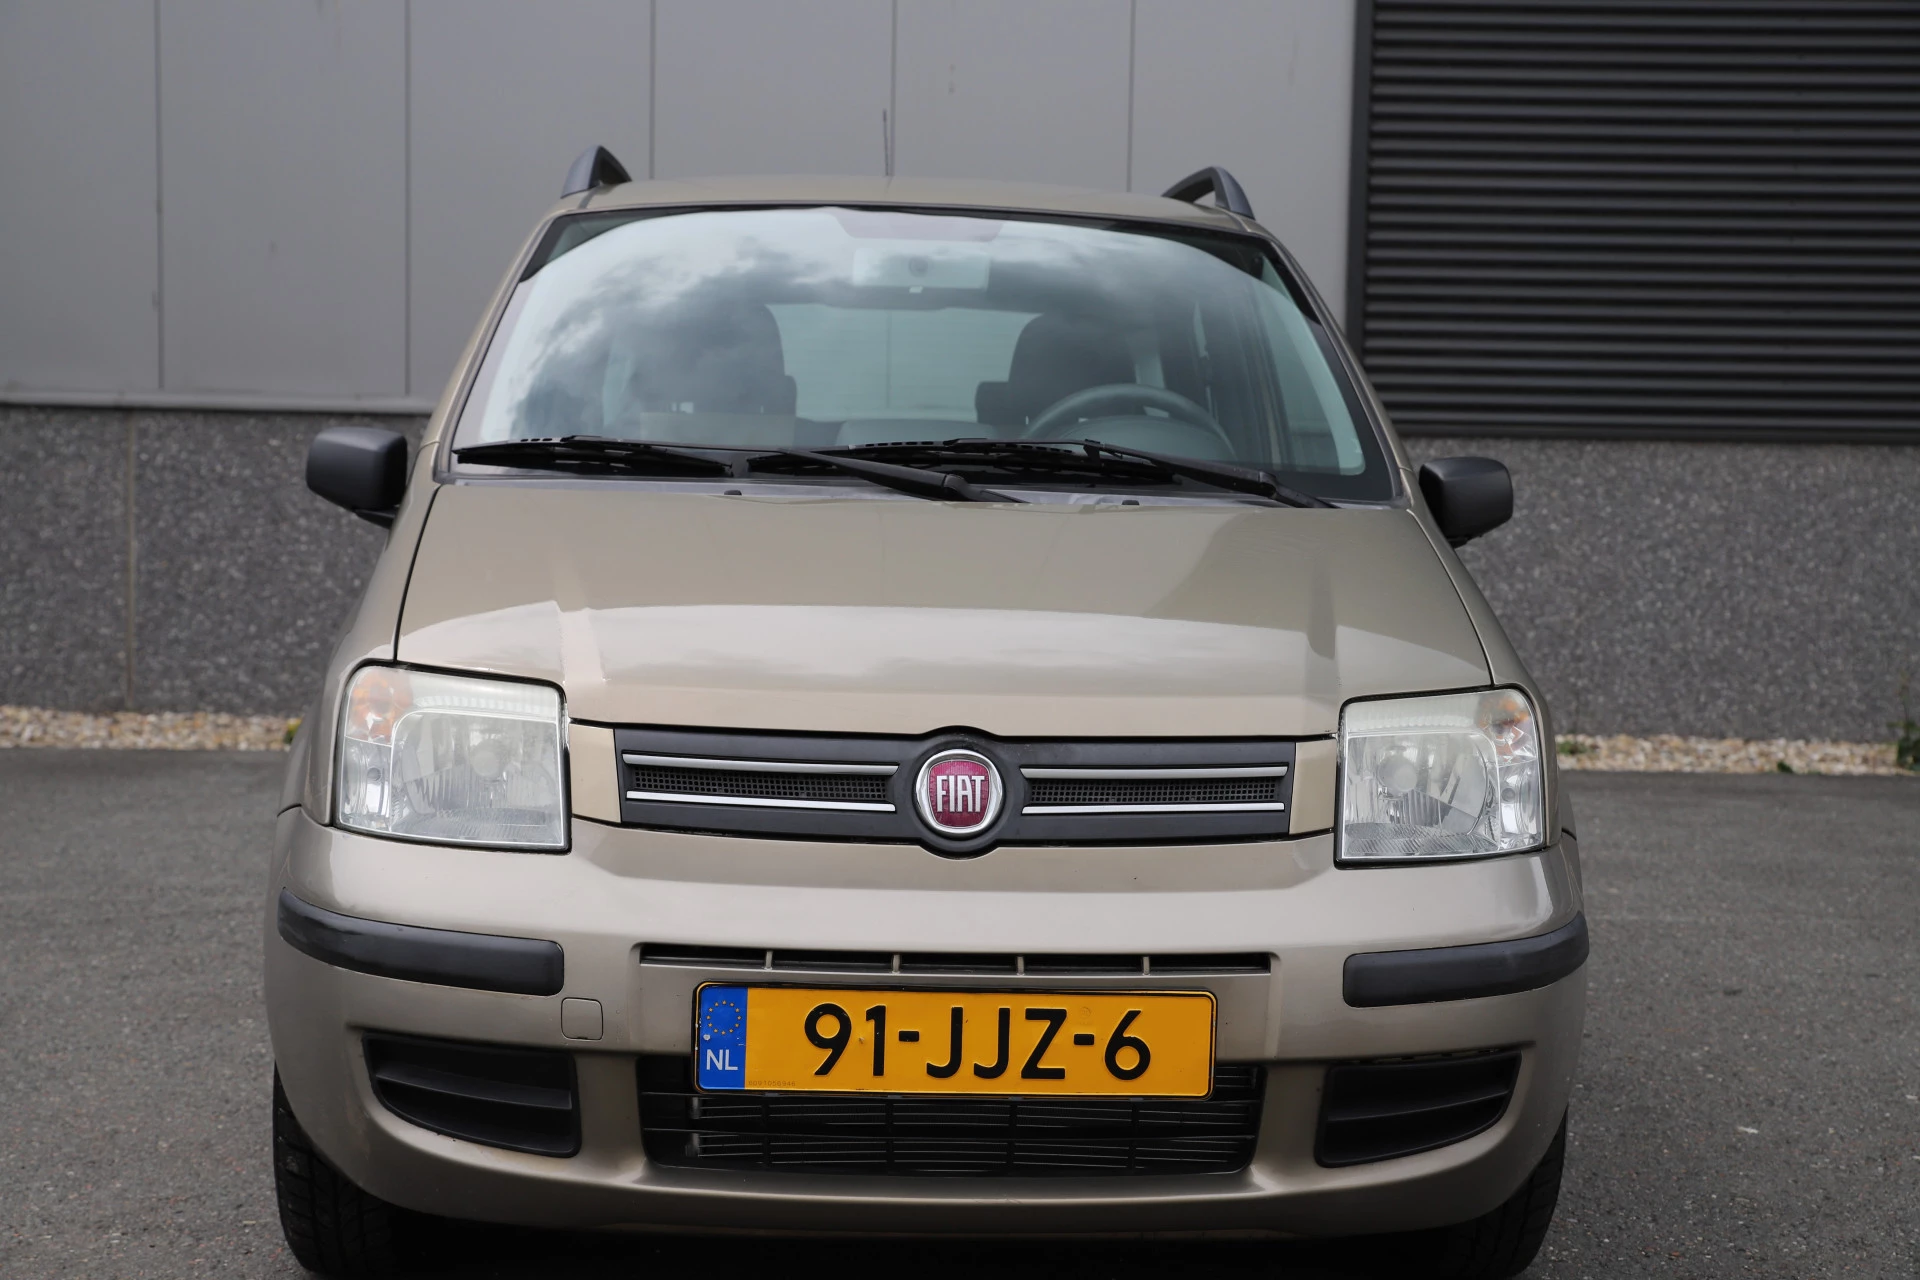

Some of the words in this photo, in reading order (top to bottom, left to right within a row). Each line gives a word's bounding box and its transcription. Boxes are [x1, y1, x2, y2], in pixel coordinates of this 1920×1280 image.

[936, 775, 985, 813] FIAT
[706, 1049, 738, 1070] NL
[804, 1002, 1152, 1081] 91-JJZ-6
